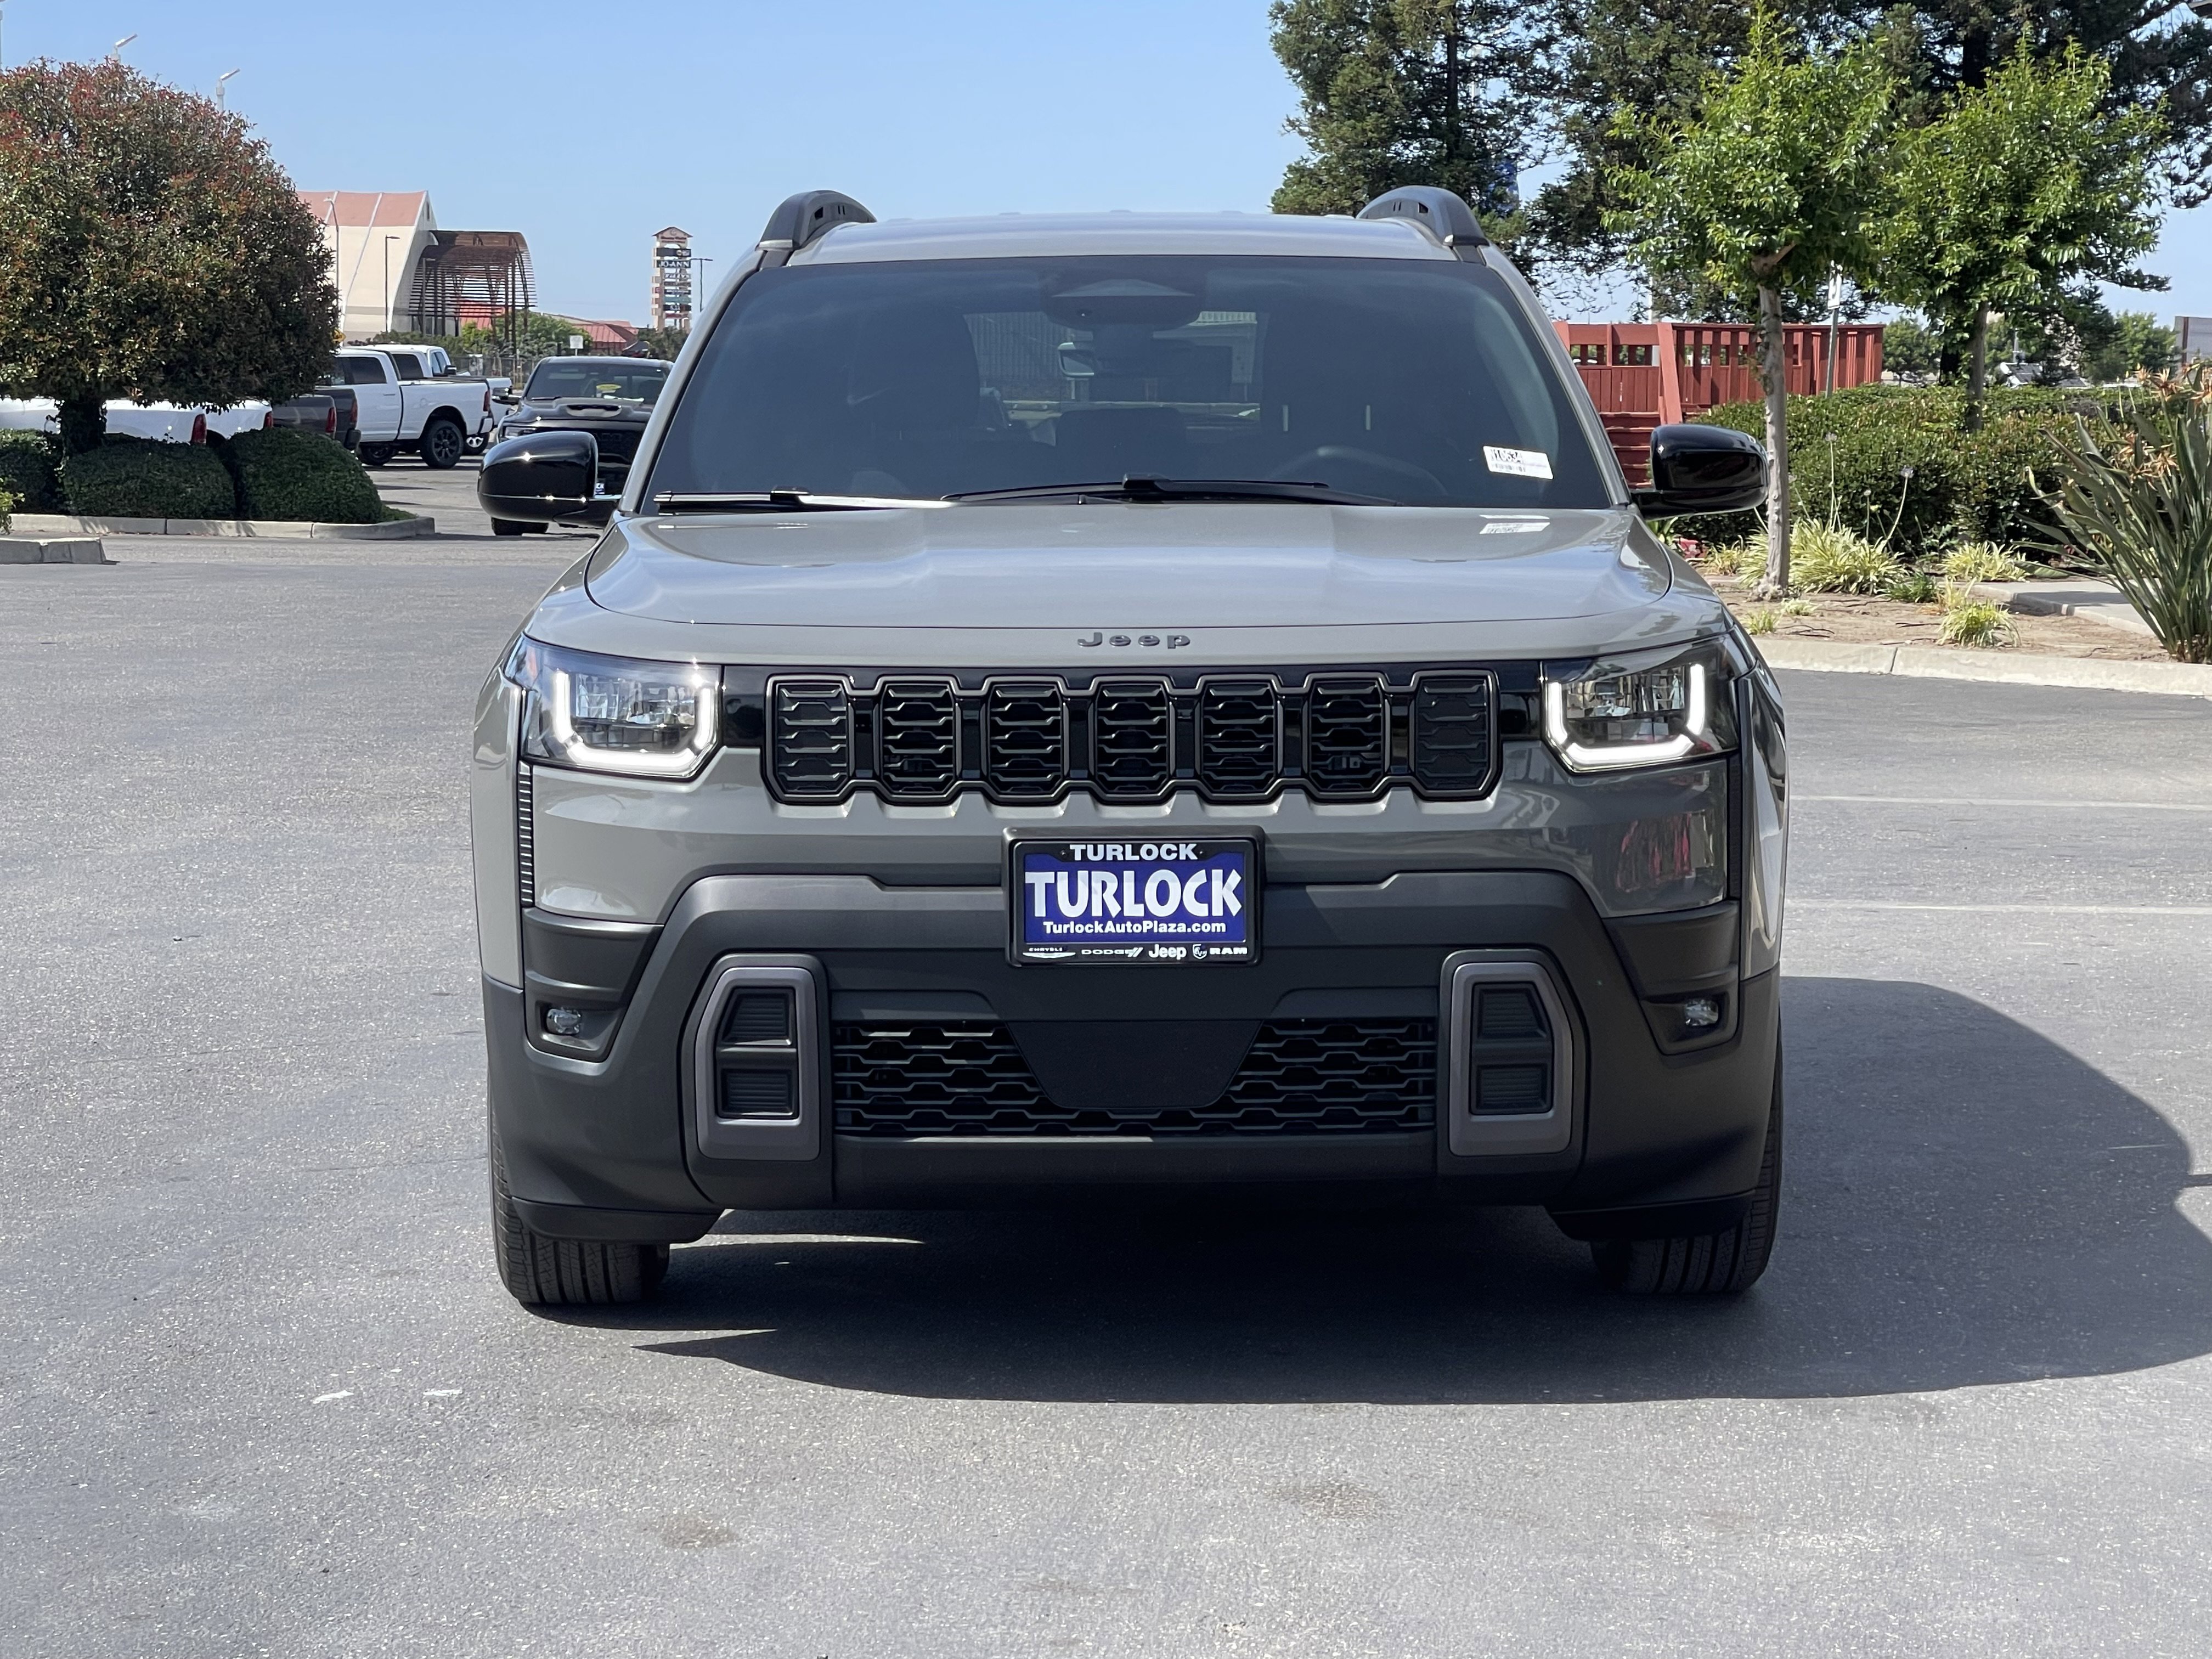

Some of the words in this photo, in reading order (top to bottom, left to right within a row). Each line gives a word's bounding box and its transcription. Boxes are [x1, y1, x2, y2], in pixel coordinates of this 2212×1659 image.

[1077, 631, 1191, 649] Jeep
[1069, 843, 1198, 861] TURLOCK
[1025, 869, 1242, 918] TURLOCK
[1043, 921, 1226, 934] TurlockAutoPlaza.com
[1148, 944, 1187, 960] Jeep
